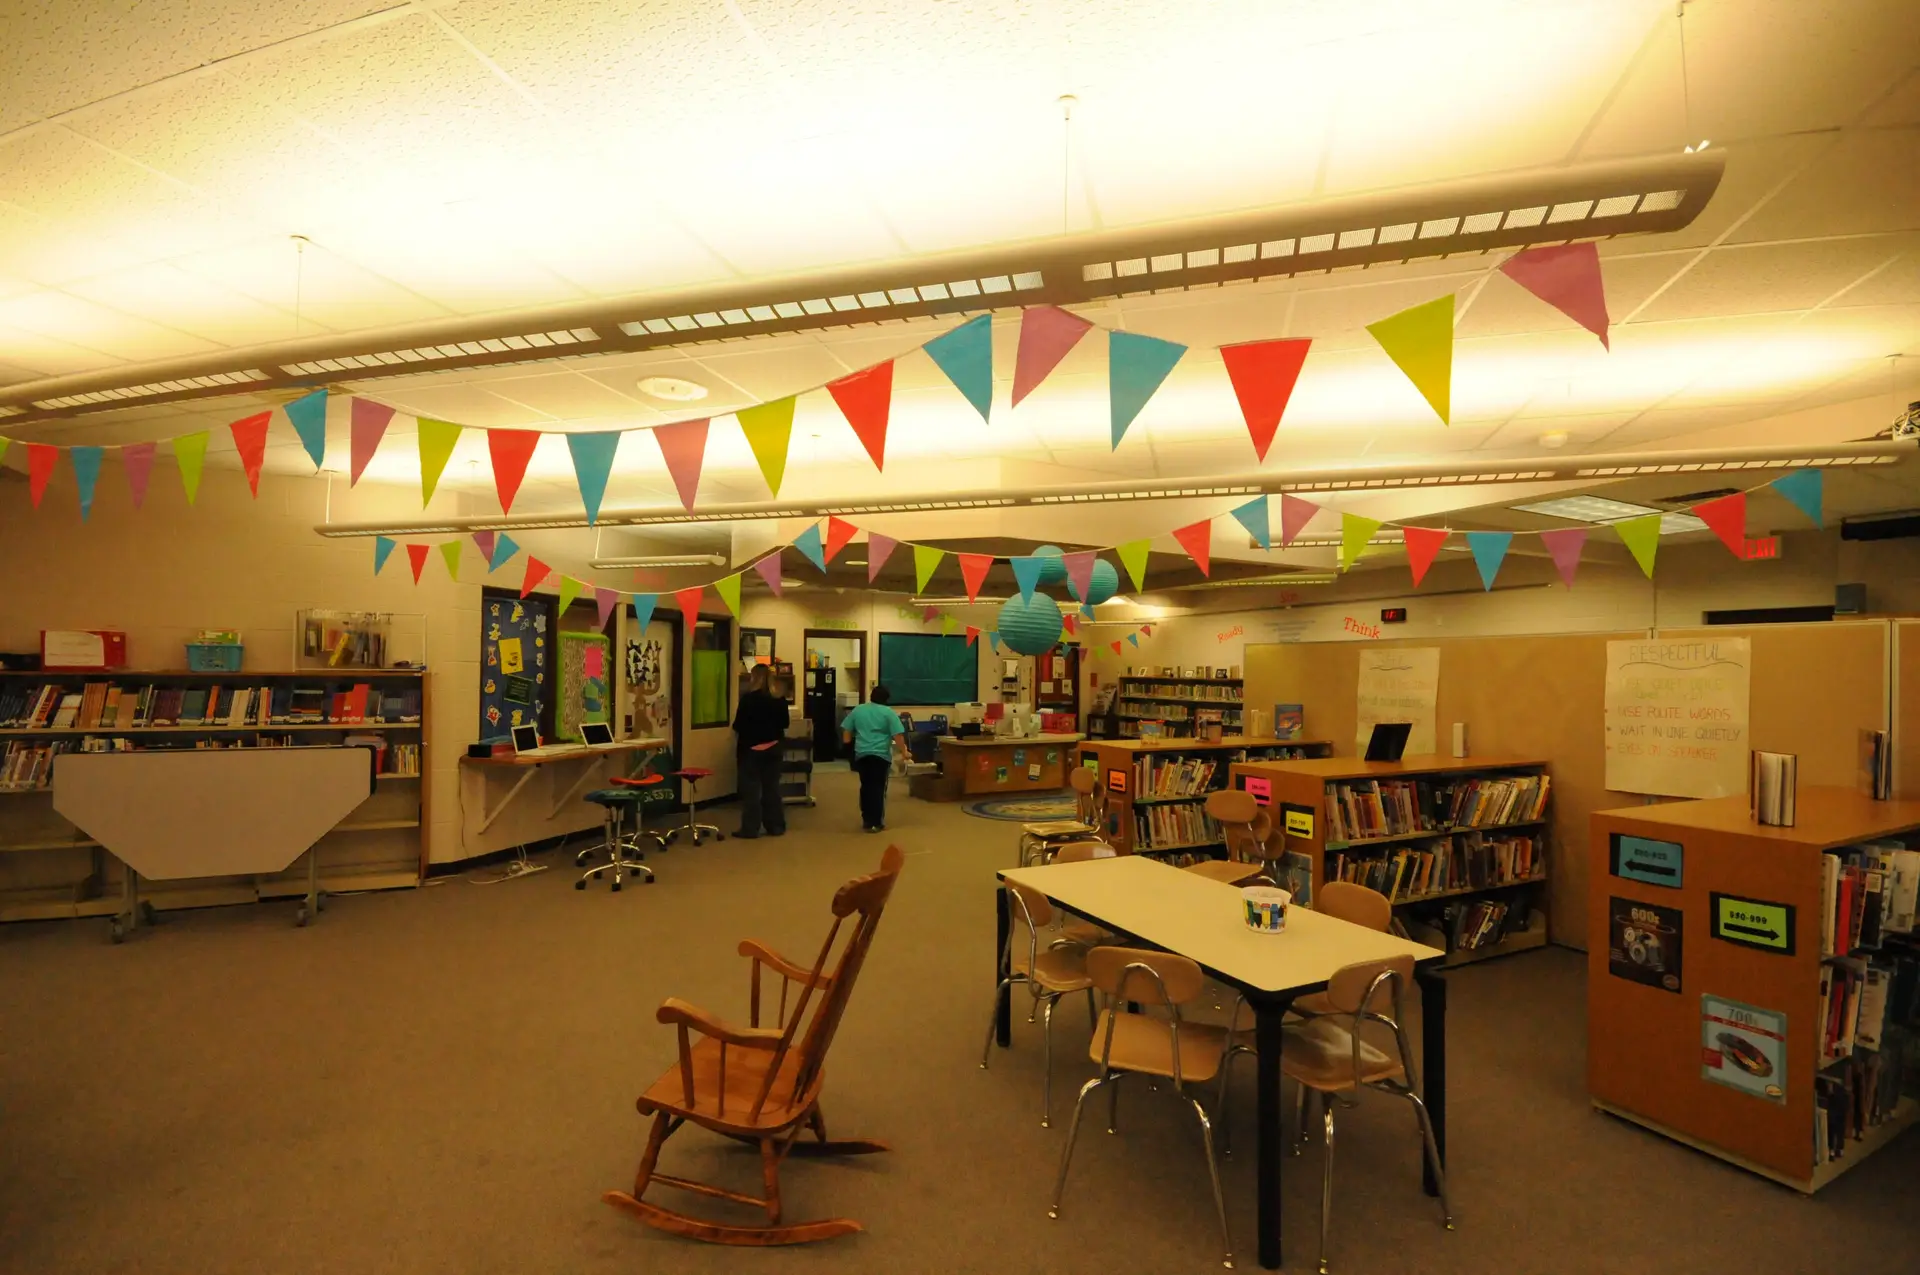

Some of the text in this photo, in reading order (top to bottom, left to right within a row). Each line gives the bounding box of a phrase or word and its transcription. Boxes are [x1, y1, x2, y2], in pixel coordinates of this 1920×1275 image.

[1746, 537, 1777, 559] EXIT
[1343, 616, 1381, 639] Think
[1629, 642, 1726, 662] RESPECTFUL
[1689, 706, 1732, 721] WORDS
[1619, 725, 1646, 736] WAIT
[1652, 726, 1662, 738] IN
[1694, 727, 1741, 742] QUIETLY
[1631, 907, 1660, 925] 600s
